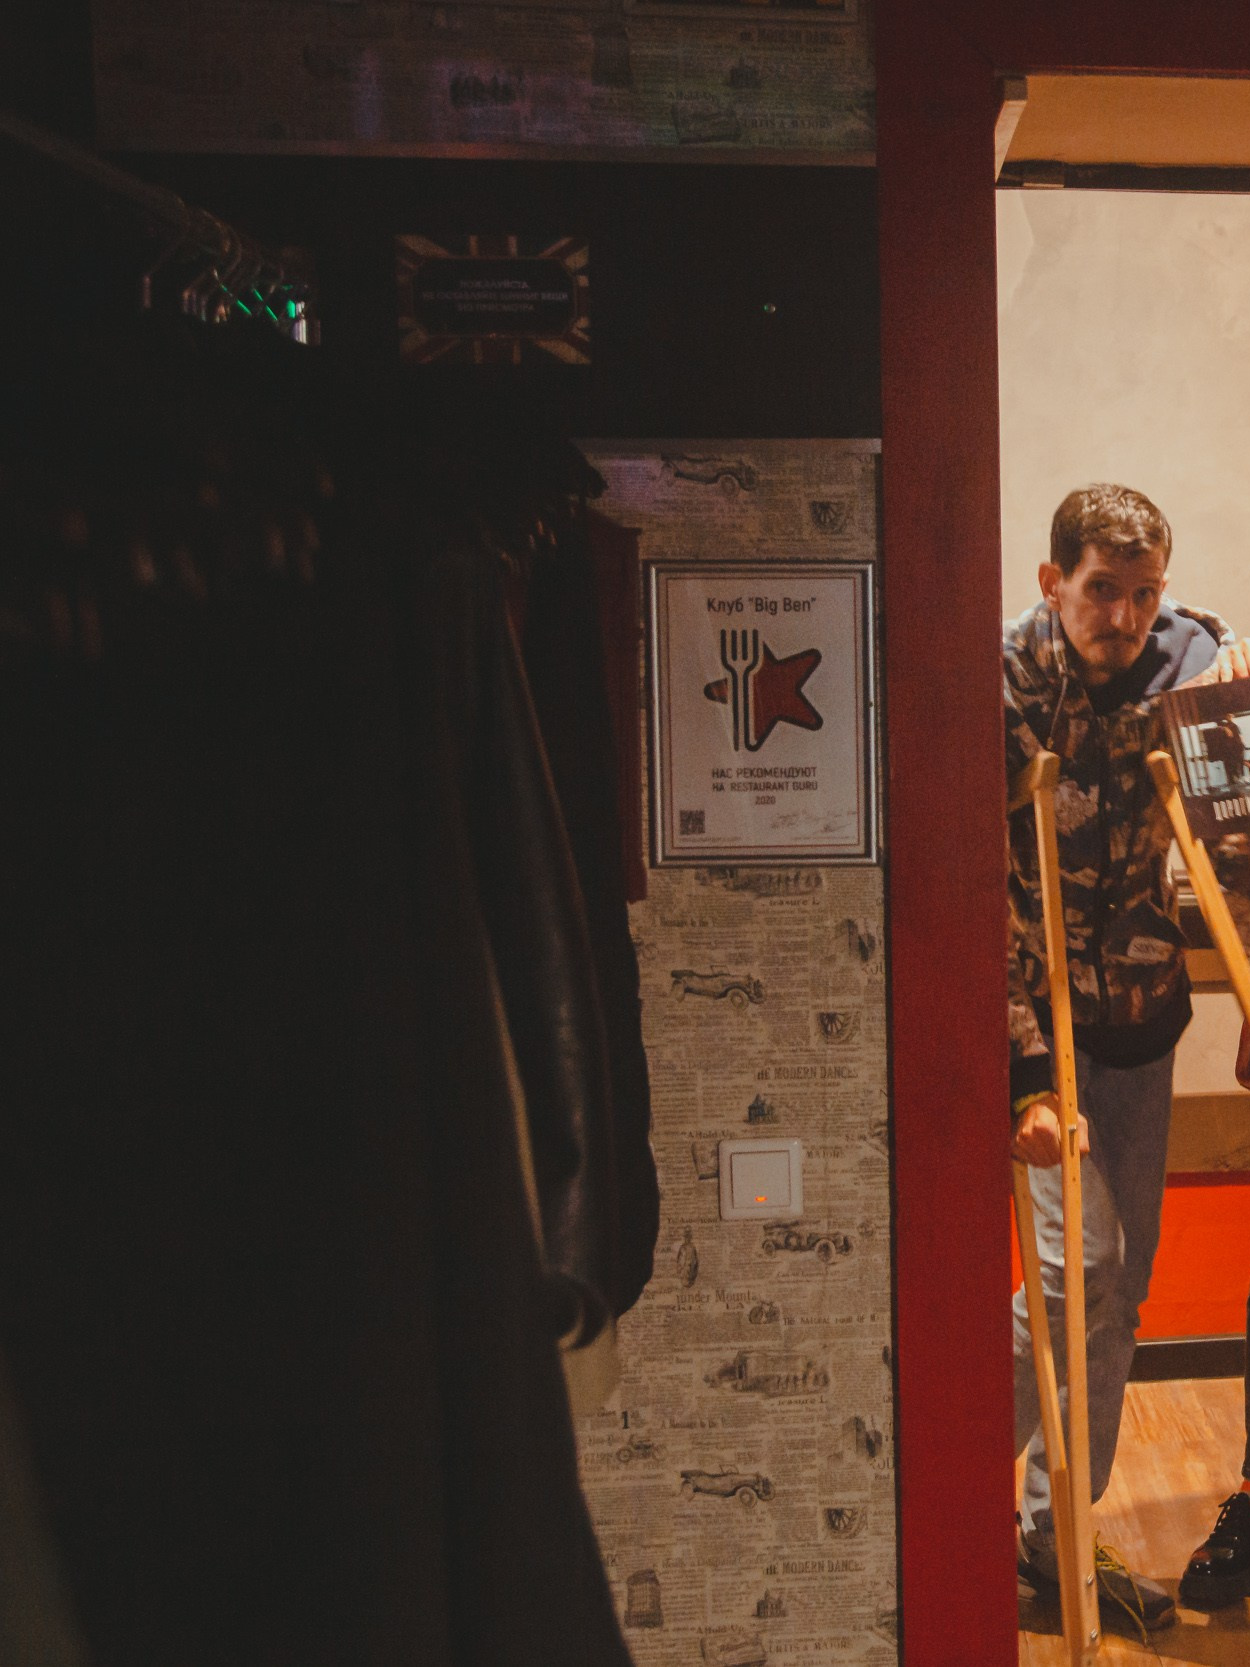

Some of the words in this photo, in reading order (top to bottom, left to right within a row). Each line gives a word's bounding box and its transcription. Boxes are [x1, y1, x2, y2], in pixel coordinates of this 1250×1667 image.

[707, 597, 744, 616] Клуб
[712, 767, 732, 779] НАС
[736, 766, 817, 779] РЕКОМЕНДУЮТ
[712, 782, 725, 793] НА
[730, 781, 790, 793] RESTAURANT
[792, 780, 818, 792] GURU
[755, 795, 777, 806] 2020
